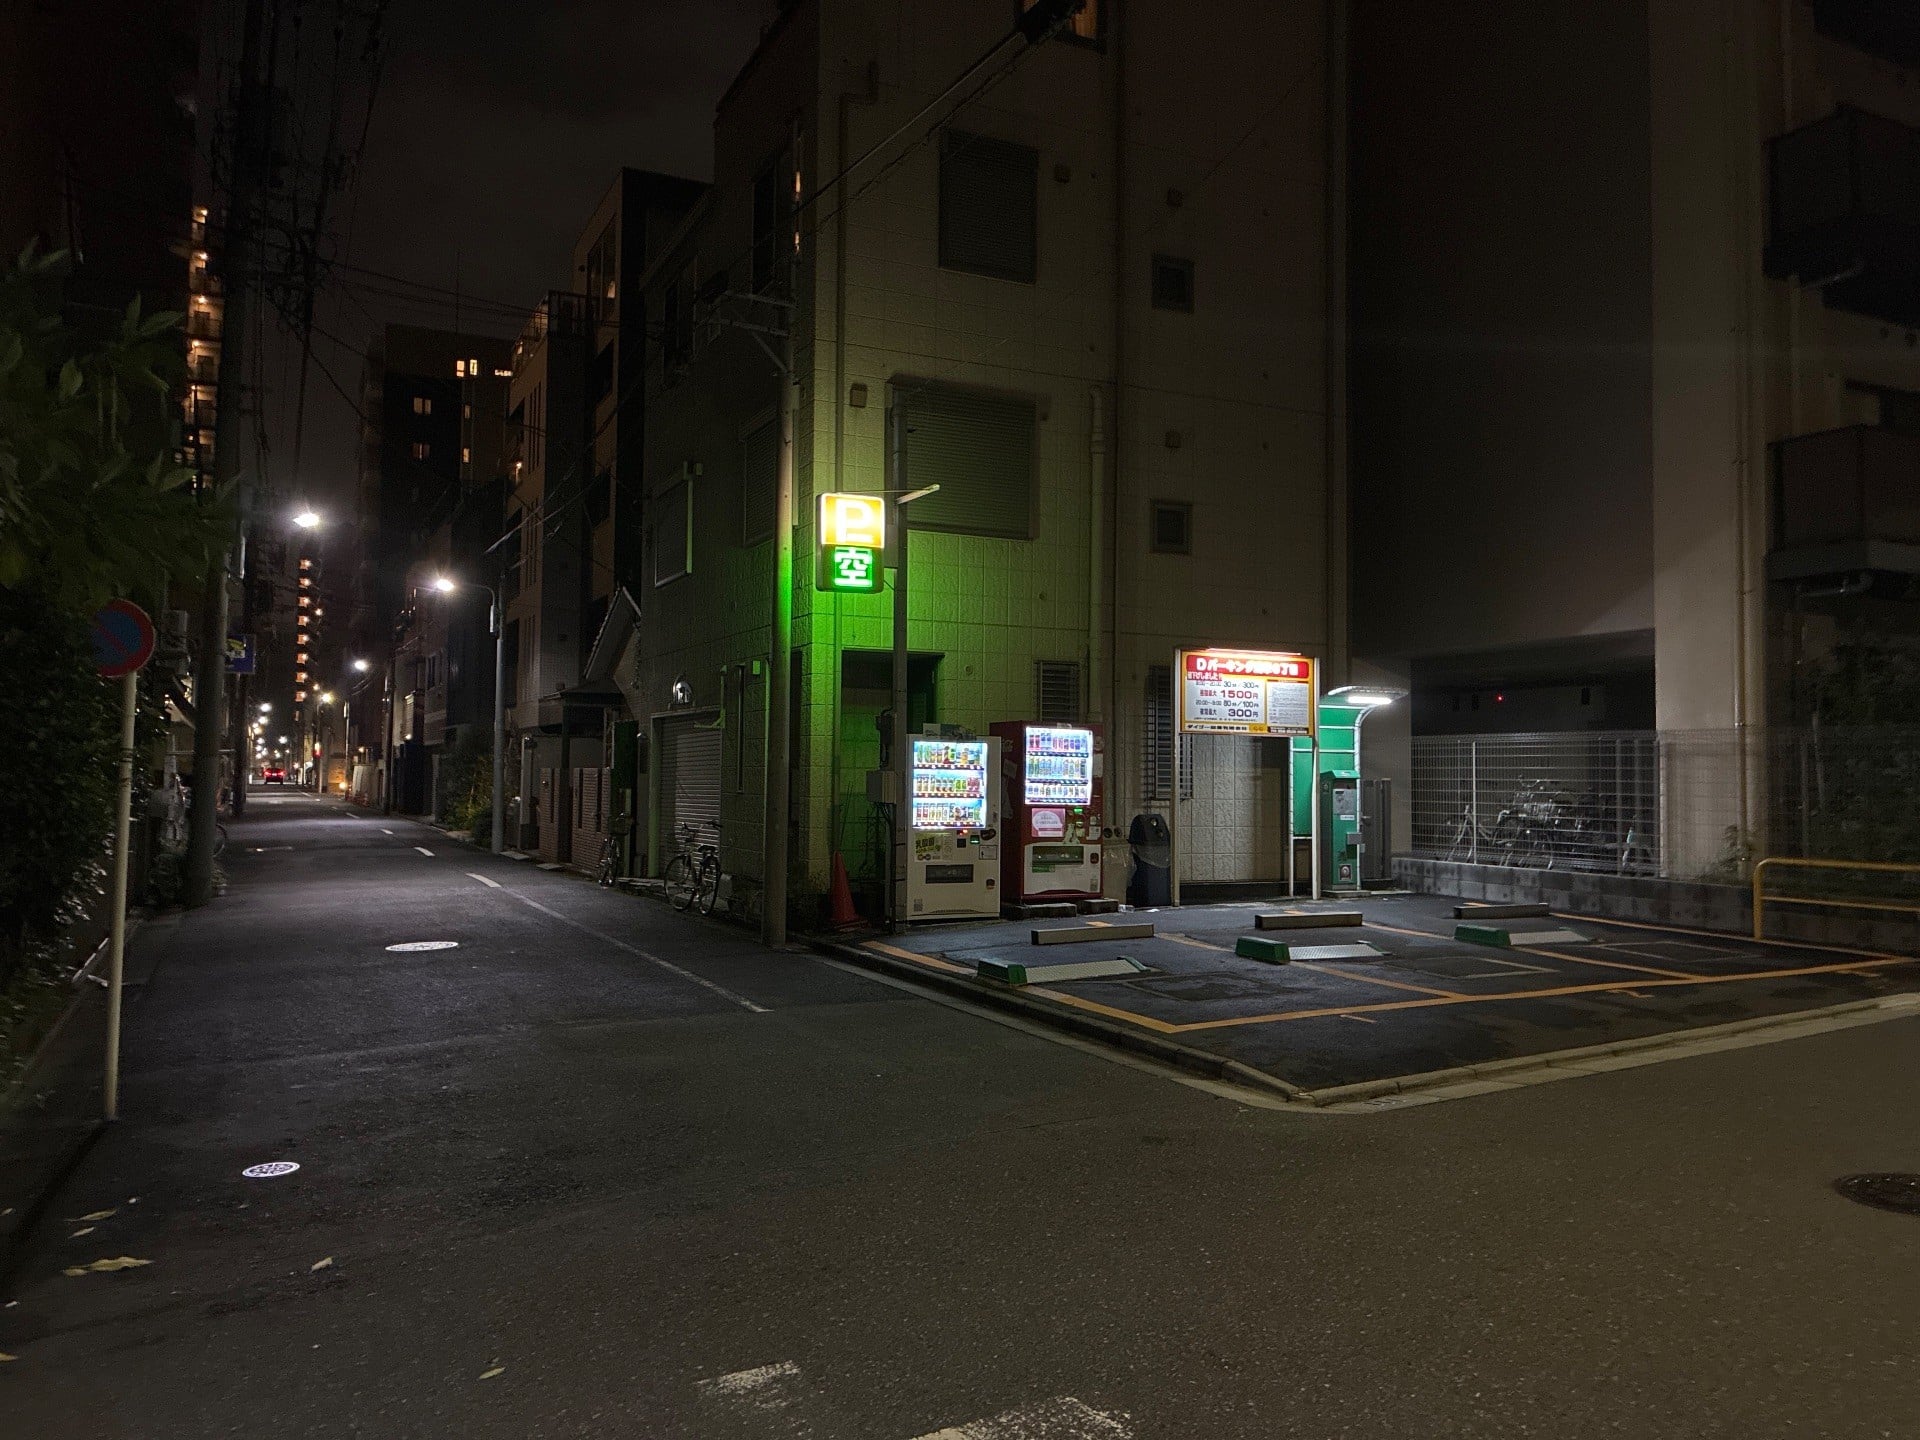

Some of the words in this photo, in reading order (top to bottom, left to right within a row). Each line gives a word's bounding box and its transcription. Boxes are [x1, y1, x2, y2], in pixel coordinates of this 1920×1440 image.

[835, 498, 875, 543] P
[834, 546, 873, 588] 空
[1220, 689, 1259, 699] 1500円
[1227, 708, 1259, 718] 300円
